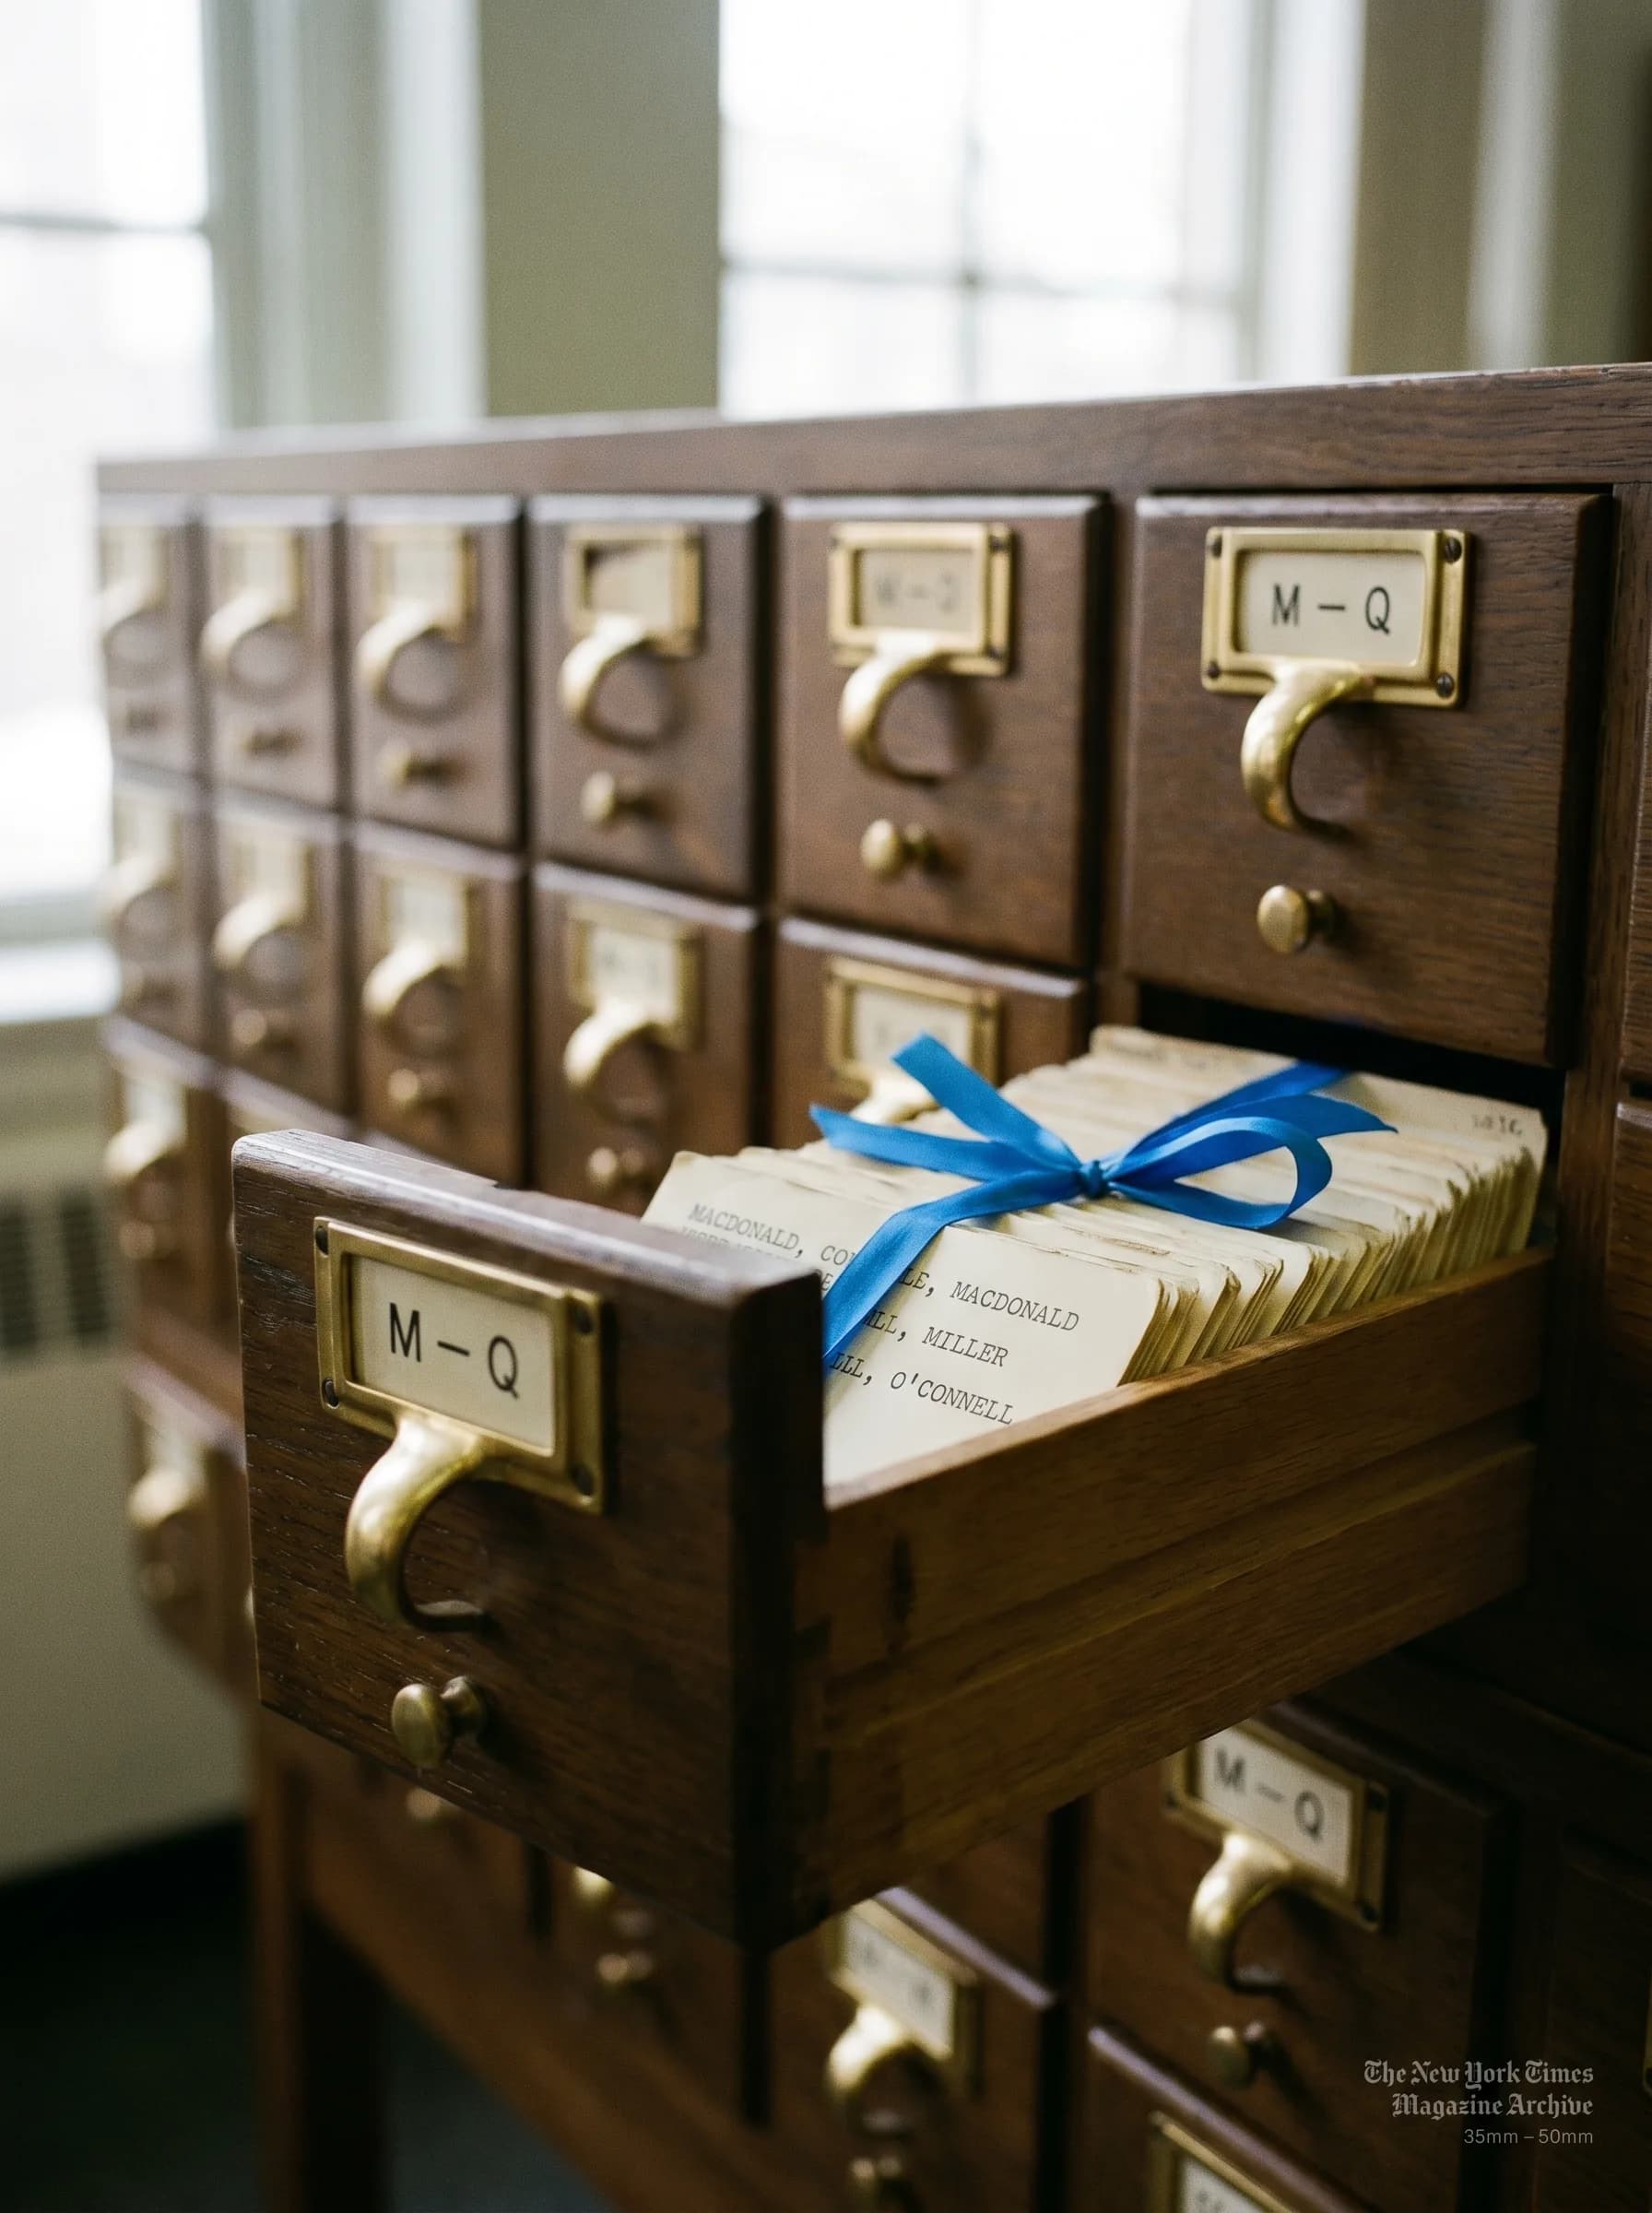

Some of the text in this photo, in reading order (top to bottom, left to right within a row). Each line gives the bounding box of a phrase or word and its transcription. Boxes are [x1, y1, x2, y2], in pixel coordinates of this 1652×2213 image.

[1271, 584, 1301, 626] M
[1364, 586, 1390, 635] Q
[688, 1203, 804, 1259] MACDONALD,
[898, 1268, 1080, 1331] LE, MACDONALD
[388, 1302, 421, 1363] M
[487, 1334, 520, 1400] Q
[921, 1326, 1009, 1367] MILLER
[890, 1371, 1014, 1426] O'CONNELL
[1293, 1791, 1325, 1840] Q
